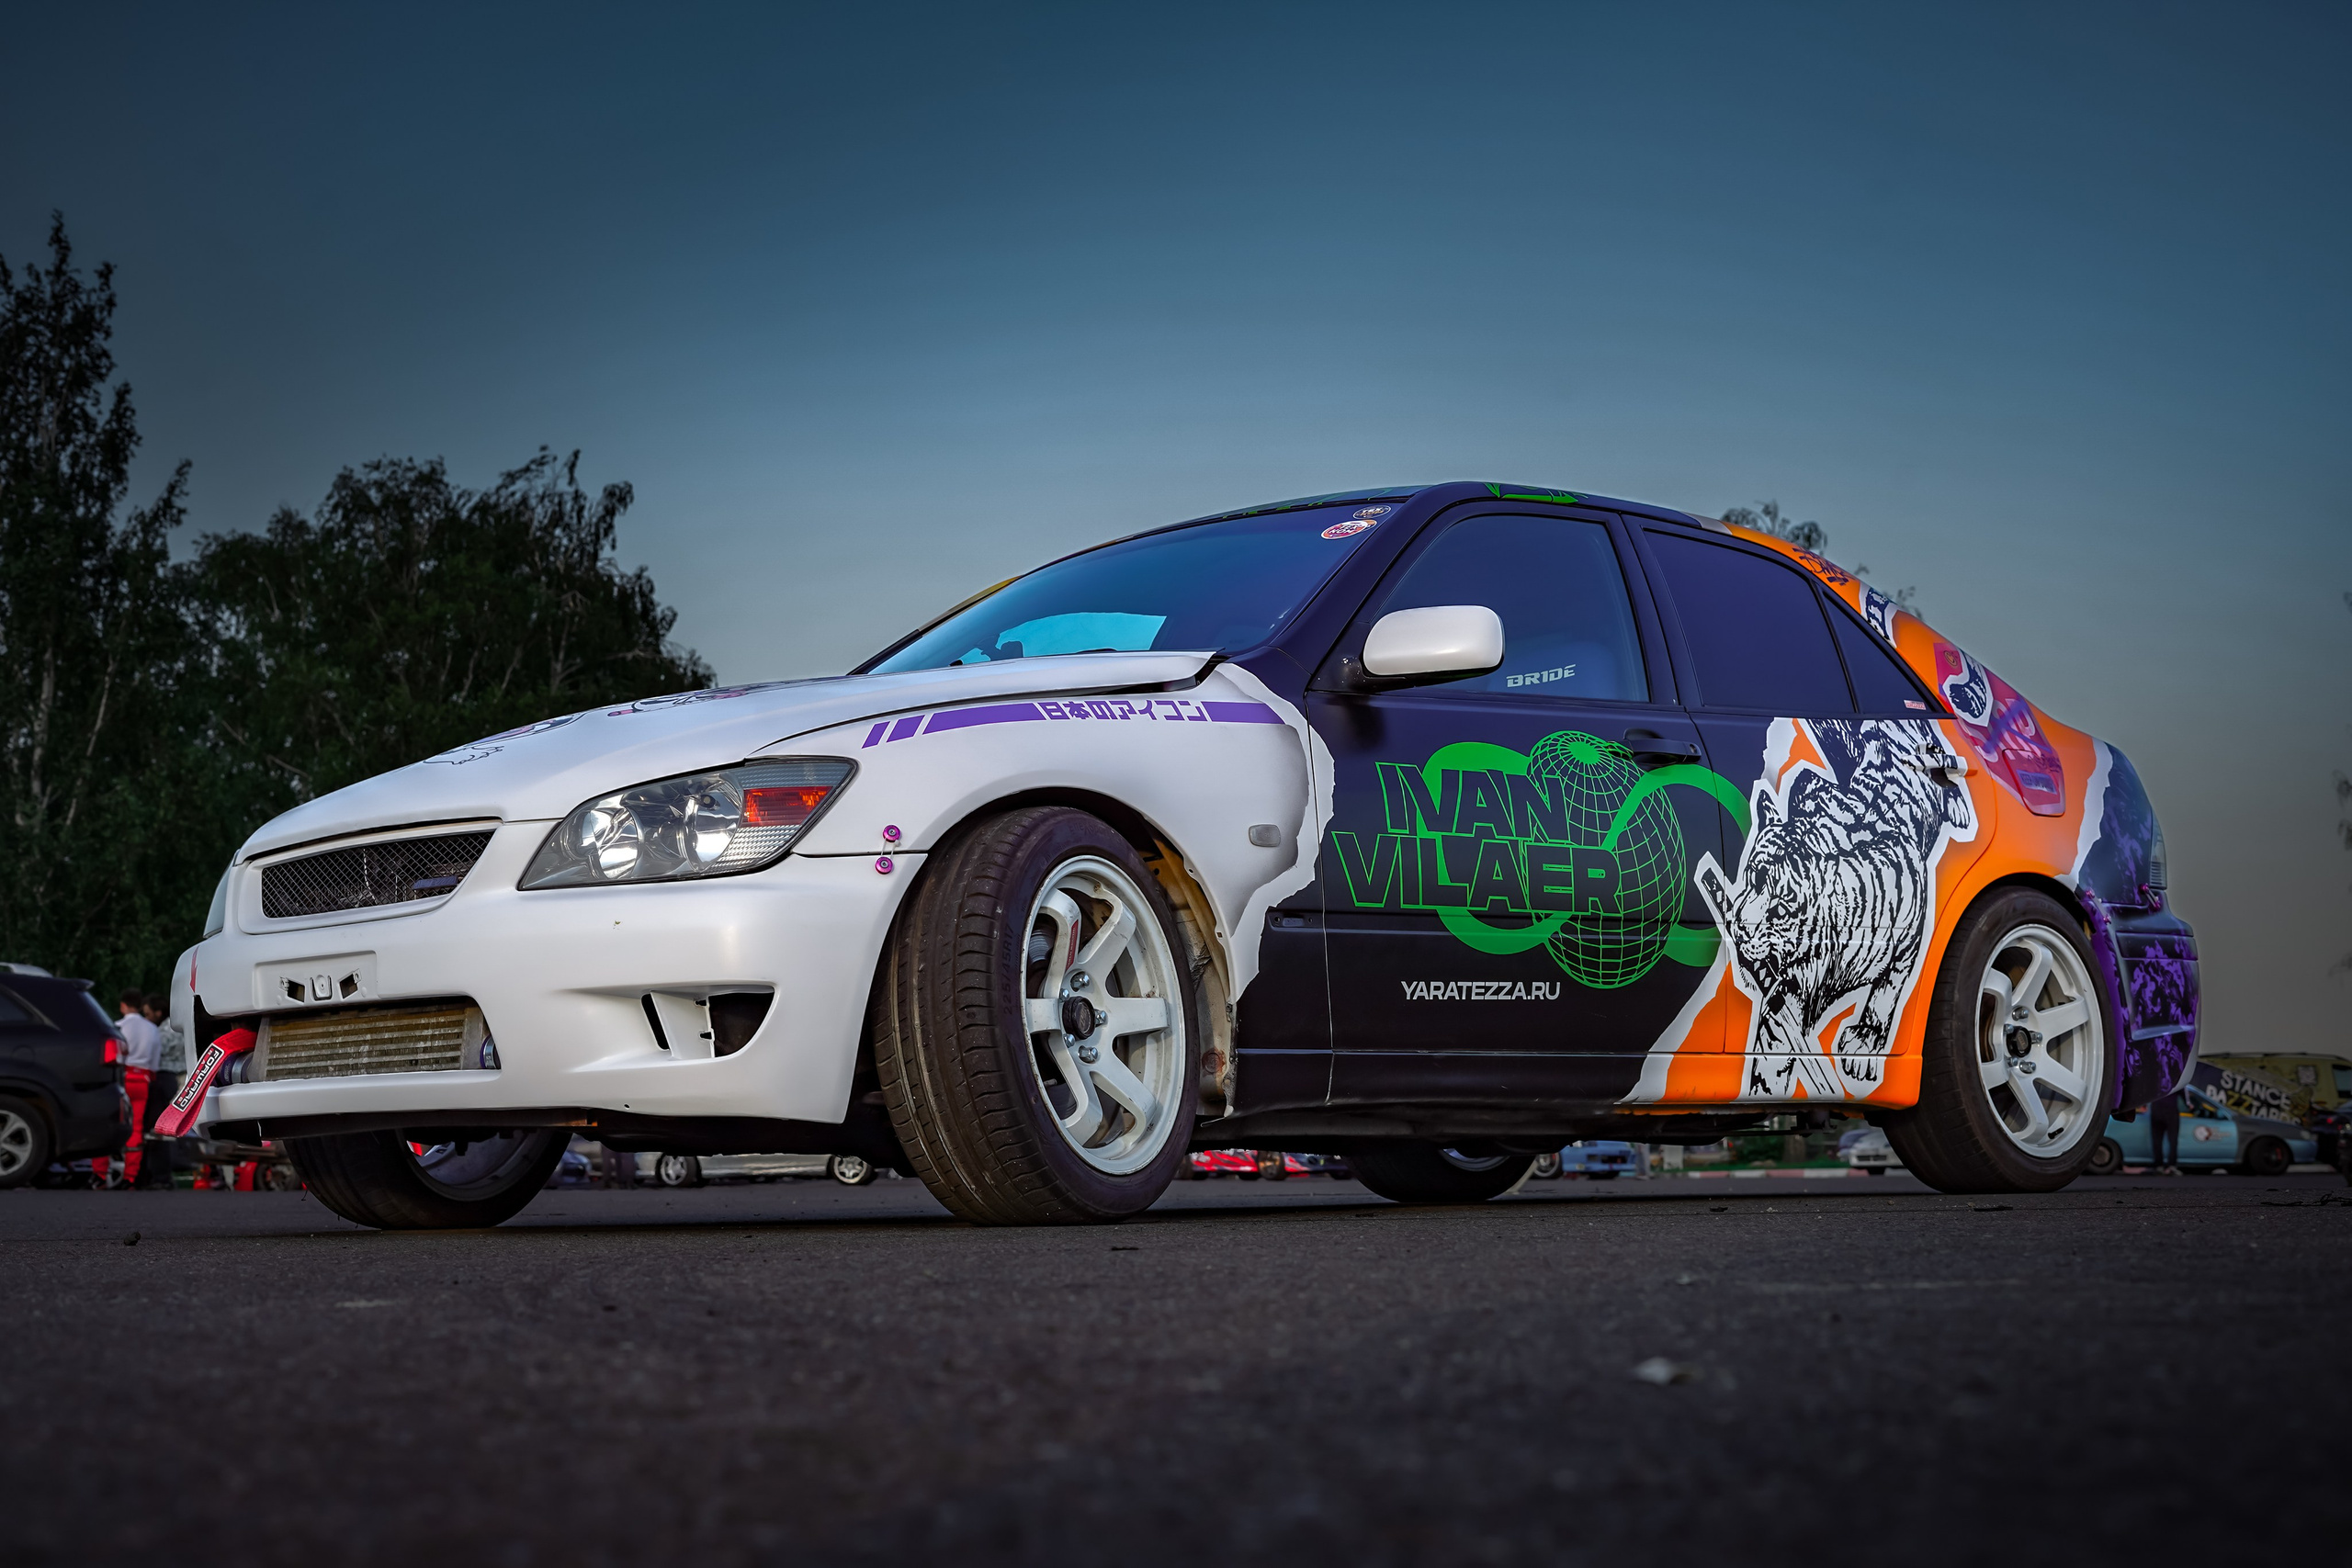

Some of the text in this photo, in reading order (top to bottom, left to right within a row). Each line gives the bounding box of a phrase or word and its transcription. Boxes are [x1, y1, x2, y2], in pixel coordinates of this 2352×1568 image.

[1506, 664, 1577, 688] BRIDE
[1037, 700, 1208, 721] 日本のアイコン
[1375, 761, 1571, 843] IVAN
[1331, 830, 1623, 917] VILAER
[1401, 981, 1560, 1000] YARATEZZA.RU
[180, 1050, 220, 1108] FORWARD
[2220, 1070, 2291, 1110] STANCE
